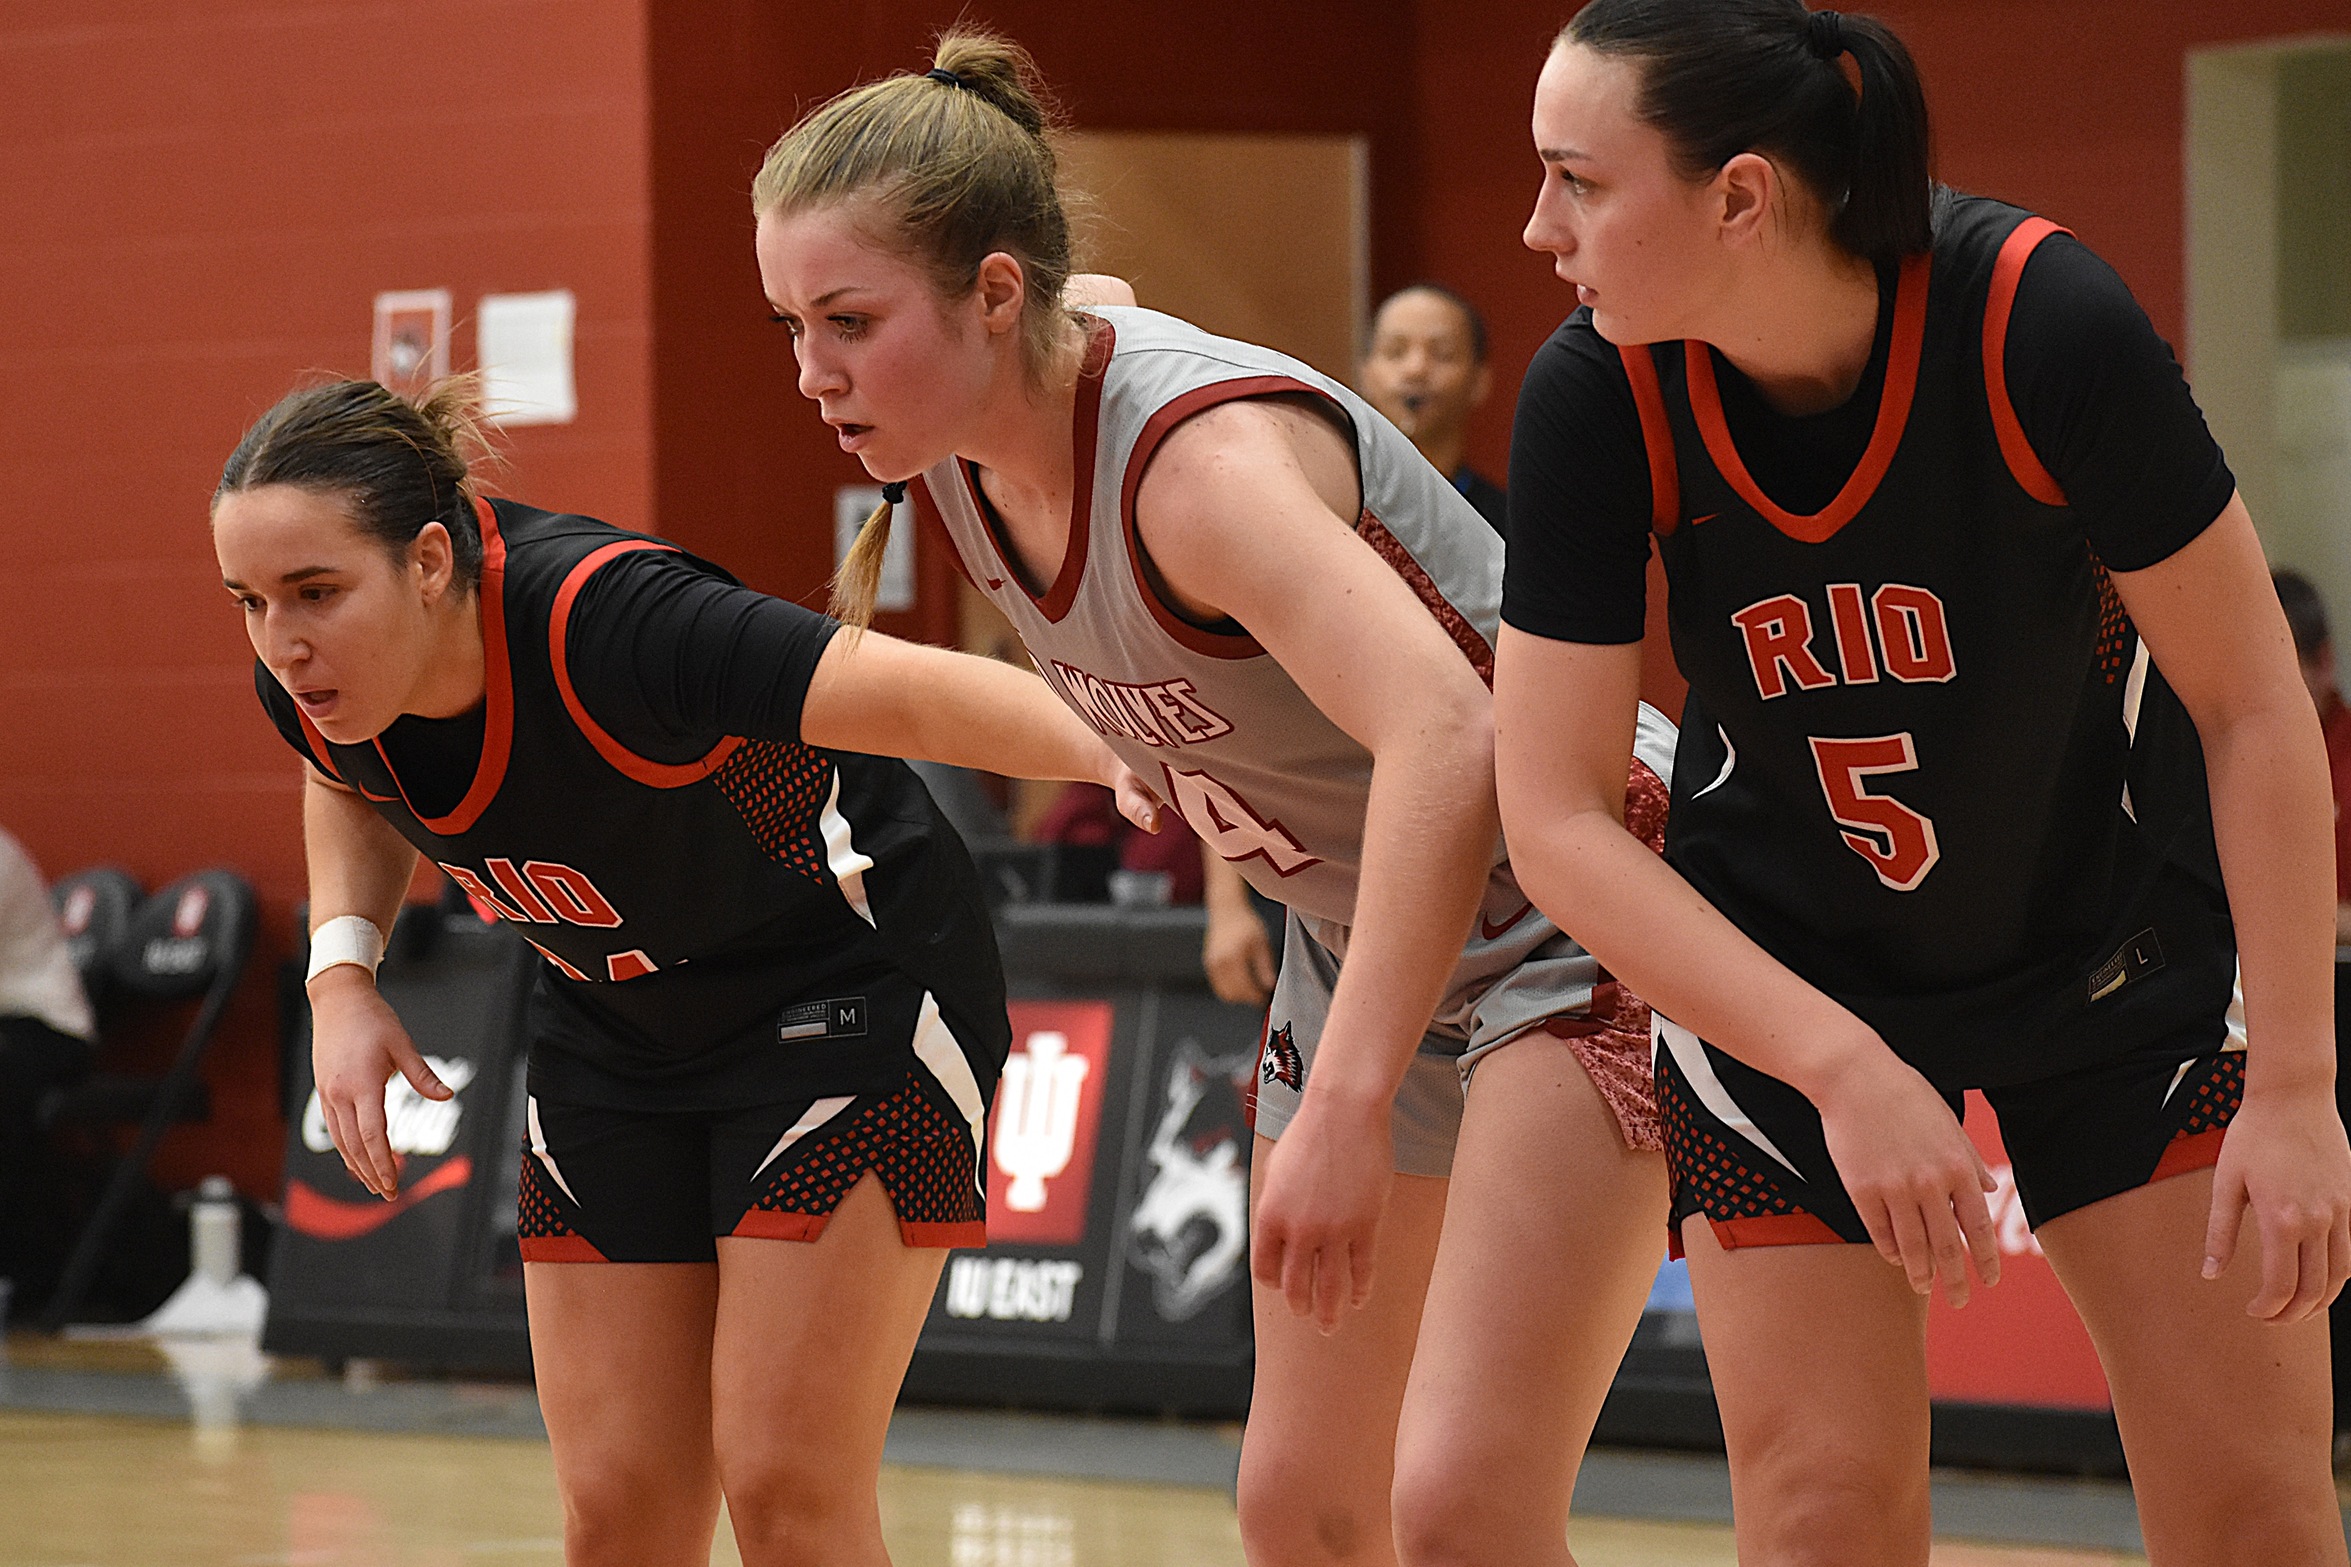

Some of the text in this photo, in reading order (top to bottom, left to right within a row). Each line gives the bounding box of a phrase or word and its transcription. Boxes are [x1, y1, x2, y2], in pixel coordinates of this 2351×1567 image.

[1731, 583, 1957, 700] RIO
[1050, 658, 1235, 749] WOLVES
[1158, 760, 1326, 879] 4
[1807, 731, 1941, 891] 5
[437, 857, 624, 929] RIO
[2135, 947, 2149, 965] L
[840, 1008, 855, 1025] M
